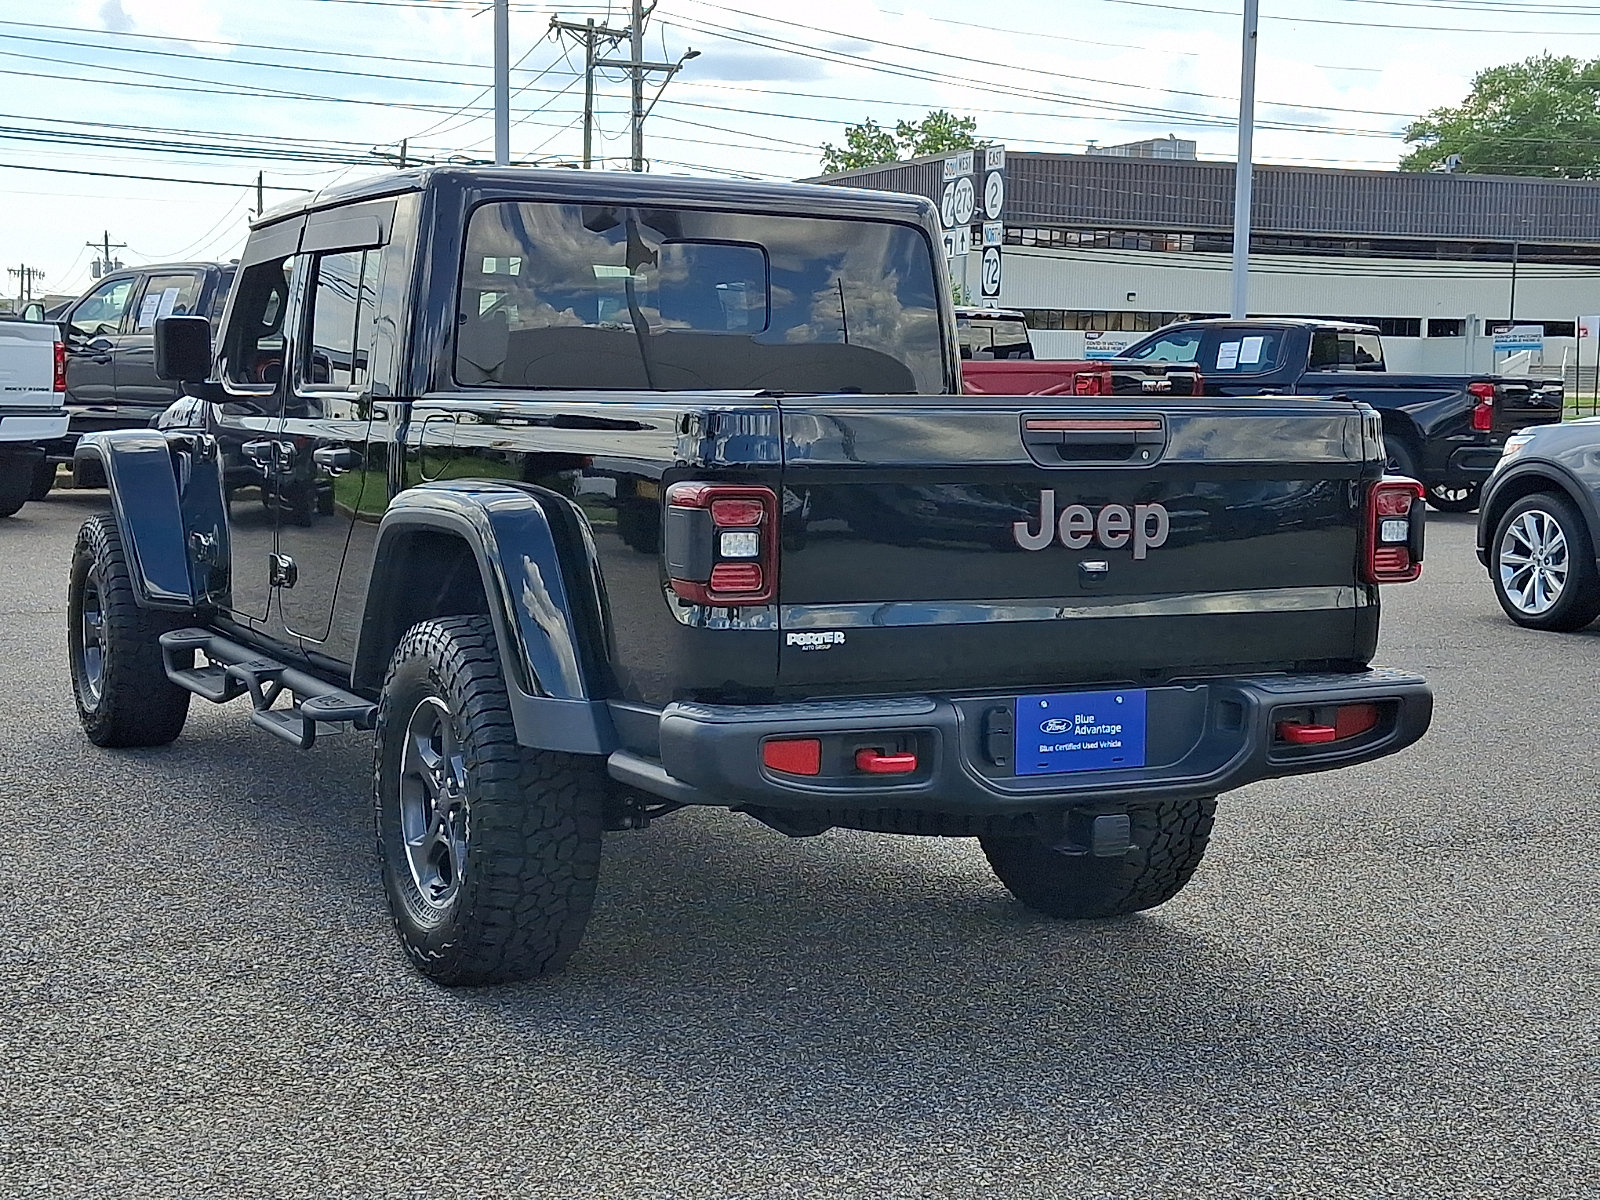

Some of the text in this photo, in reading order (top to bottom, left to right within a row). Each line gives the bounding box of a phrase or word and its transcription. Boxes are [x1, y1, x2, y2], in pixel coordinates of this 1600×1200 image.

[958, 156, 972, 171] WEST
[988, 151, 1002, 166] EAST
[944, 161, 957, 176] SOU
[956, 187, 973, 214] 273
[990, 182, 998, 209] 2
[984, 226, 1001, 243] NORTH
[985, 258, 999, 285] 72
[1142, 380, 1172, 391] GMC
[1013, 489, 1170, 560] Jeep
[786, 631, 846, 646] PORTER
[1046, 720, 1067, 732] Ford
[1074, 714, 1095, 724] Blue
[1074, 724, 1122, 735] Advantage
[1039, 740, 1122, 753] Blue Certified Used Vehicle
